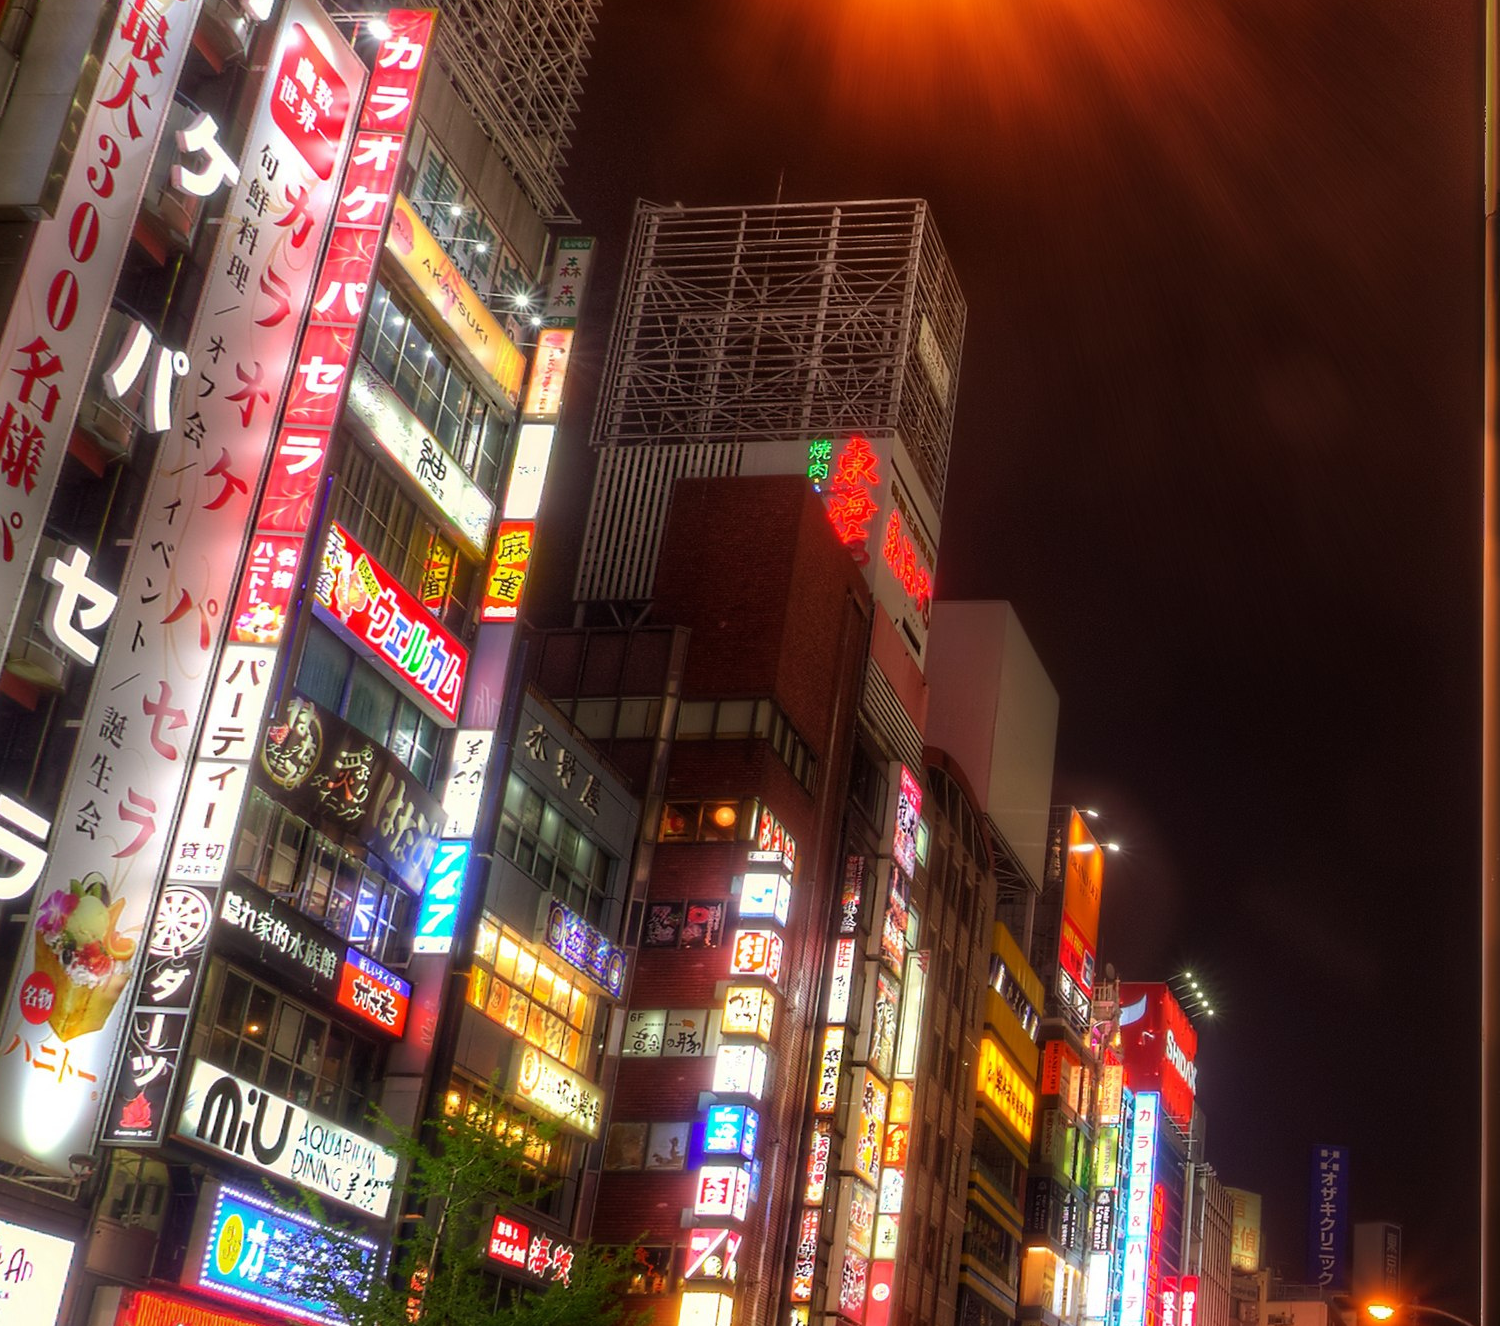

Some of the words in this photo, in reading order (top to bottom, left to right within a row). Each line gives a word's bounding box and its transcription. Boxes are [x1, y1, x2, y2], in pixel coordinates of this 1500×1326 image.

[277, 32, 425, 477] カラオケパセラ
[422, 258, 490, 346] AKATSUKI
[808, 438, 833, 480] 焼肉
[111, 178, 316, 862] カラオケパセラ
[367, 586, 464, 717] ウェルカム
[201, 656, 272, 831] パーティー
[176, 839, 226, 865] 貸切
[22, 984, 53, 1009] 名物
[629, 1012, 645, 1023] 6F
[125, 965, 193, 1088] ダーツ
[4, 1033, 98, 1085] ハニトー
[291, 1149, 342, 1193] DINING
[298, 1118, 378, 1174] AQUARIUM
